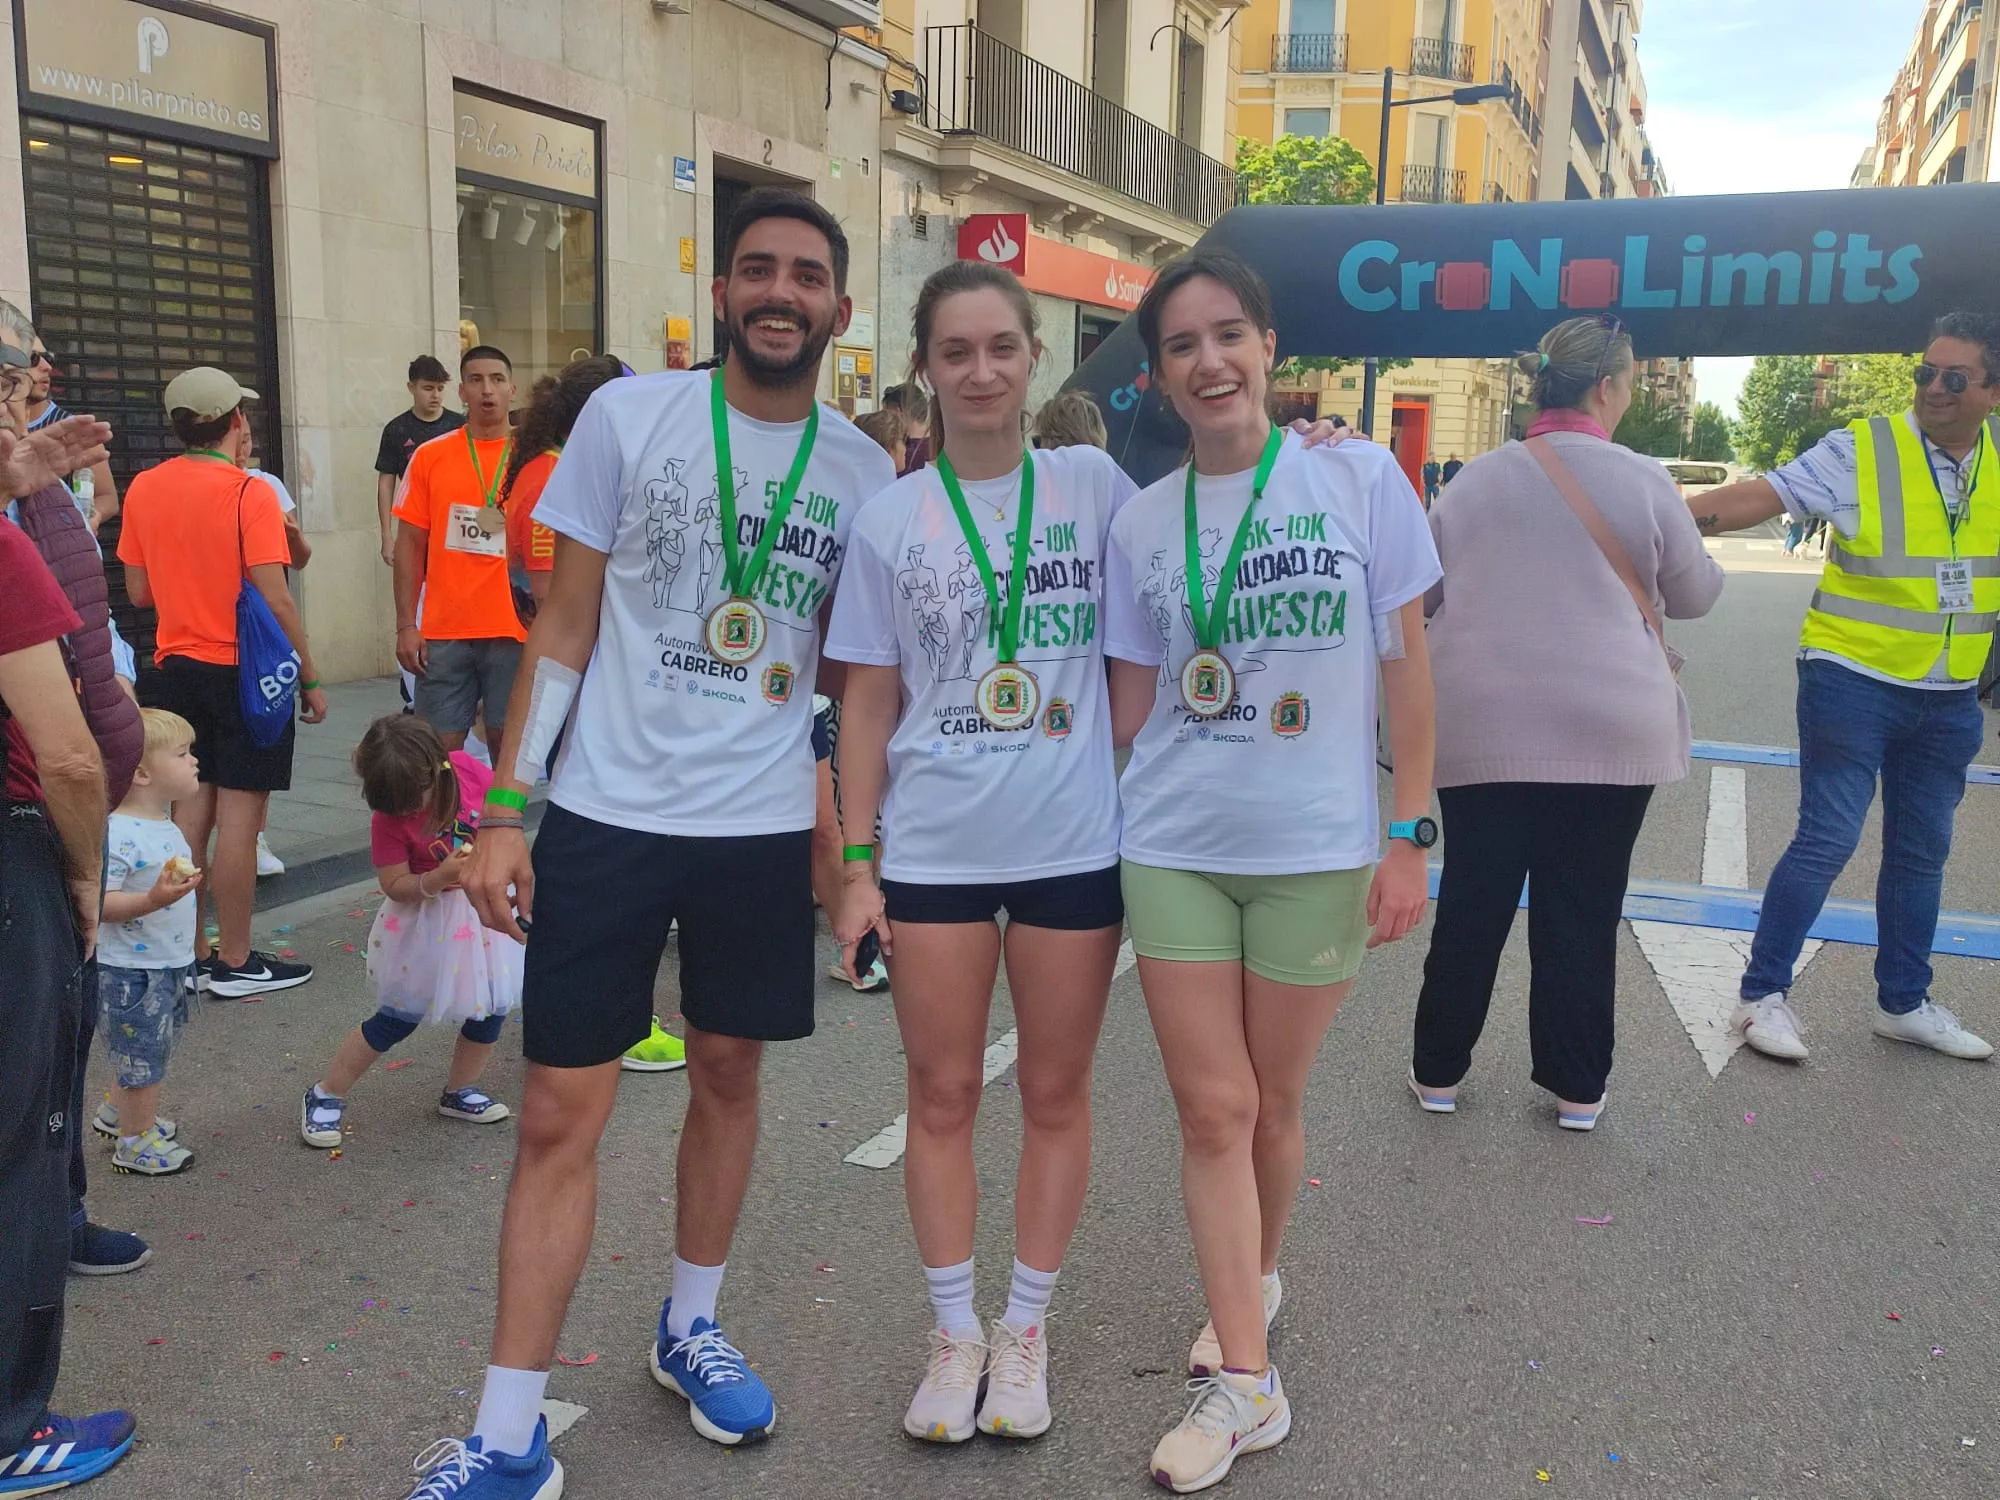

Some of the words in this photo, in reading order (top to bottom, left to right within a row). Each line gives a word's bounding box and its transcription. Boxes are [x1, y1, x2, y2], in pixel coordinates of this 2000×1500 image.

[37, 64, 262, 132] www.pilarprieto.es
[459, 115, 522, 161] Pilar
[531, 133, 592, 178] Prieto
[763, 139, 773, 166] 2
[1221, 546, 1308, 594] IUDAD
[1314, 547, 1344, 580] DE
[1222, 590, 1347, 644] HUESCA
[661, 650, 748, 682] CABRERO
